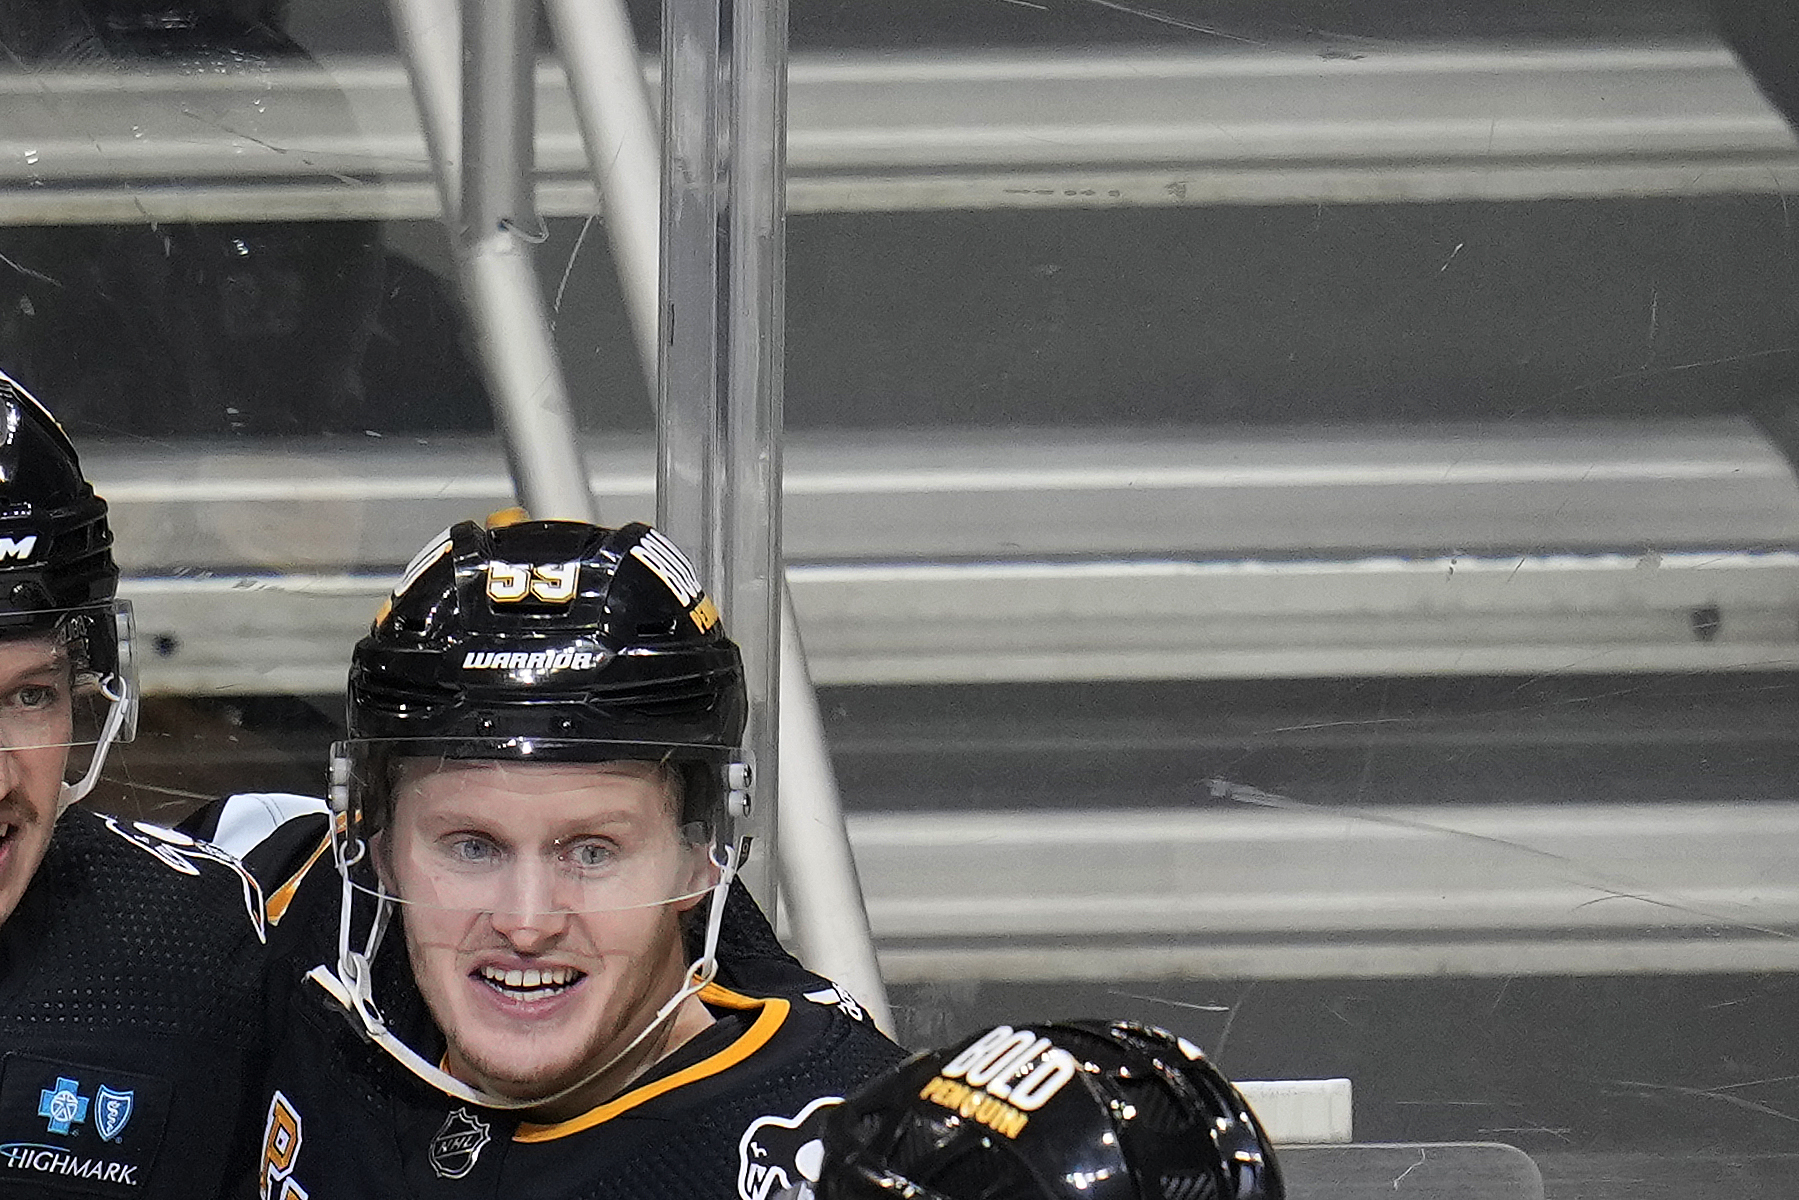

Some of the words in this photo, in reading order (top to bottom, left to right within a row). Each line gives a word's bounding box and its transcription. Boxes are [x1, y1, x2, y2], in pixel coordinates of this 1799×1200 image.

[462, 651, 595, 670] WARRIOR
[940, 1025, 1076, 1112] BOLD
[919, 1075, 1030, 1140] PENGUIN
[438, 1134, 476, 1154] NHL
